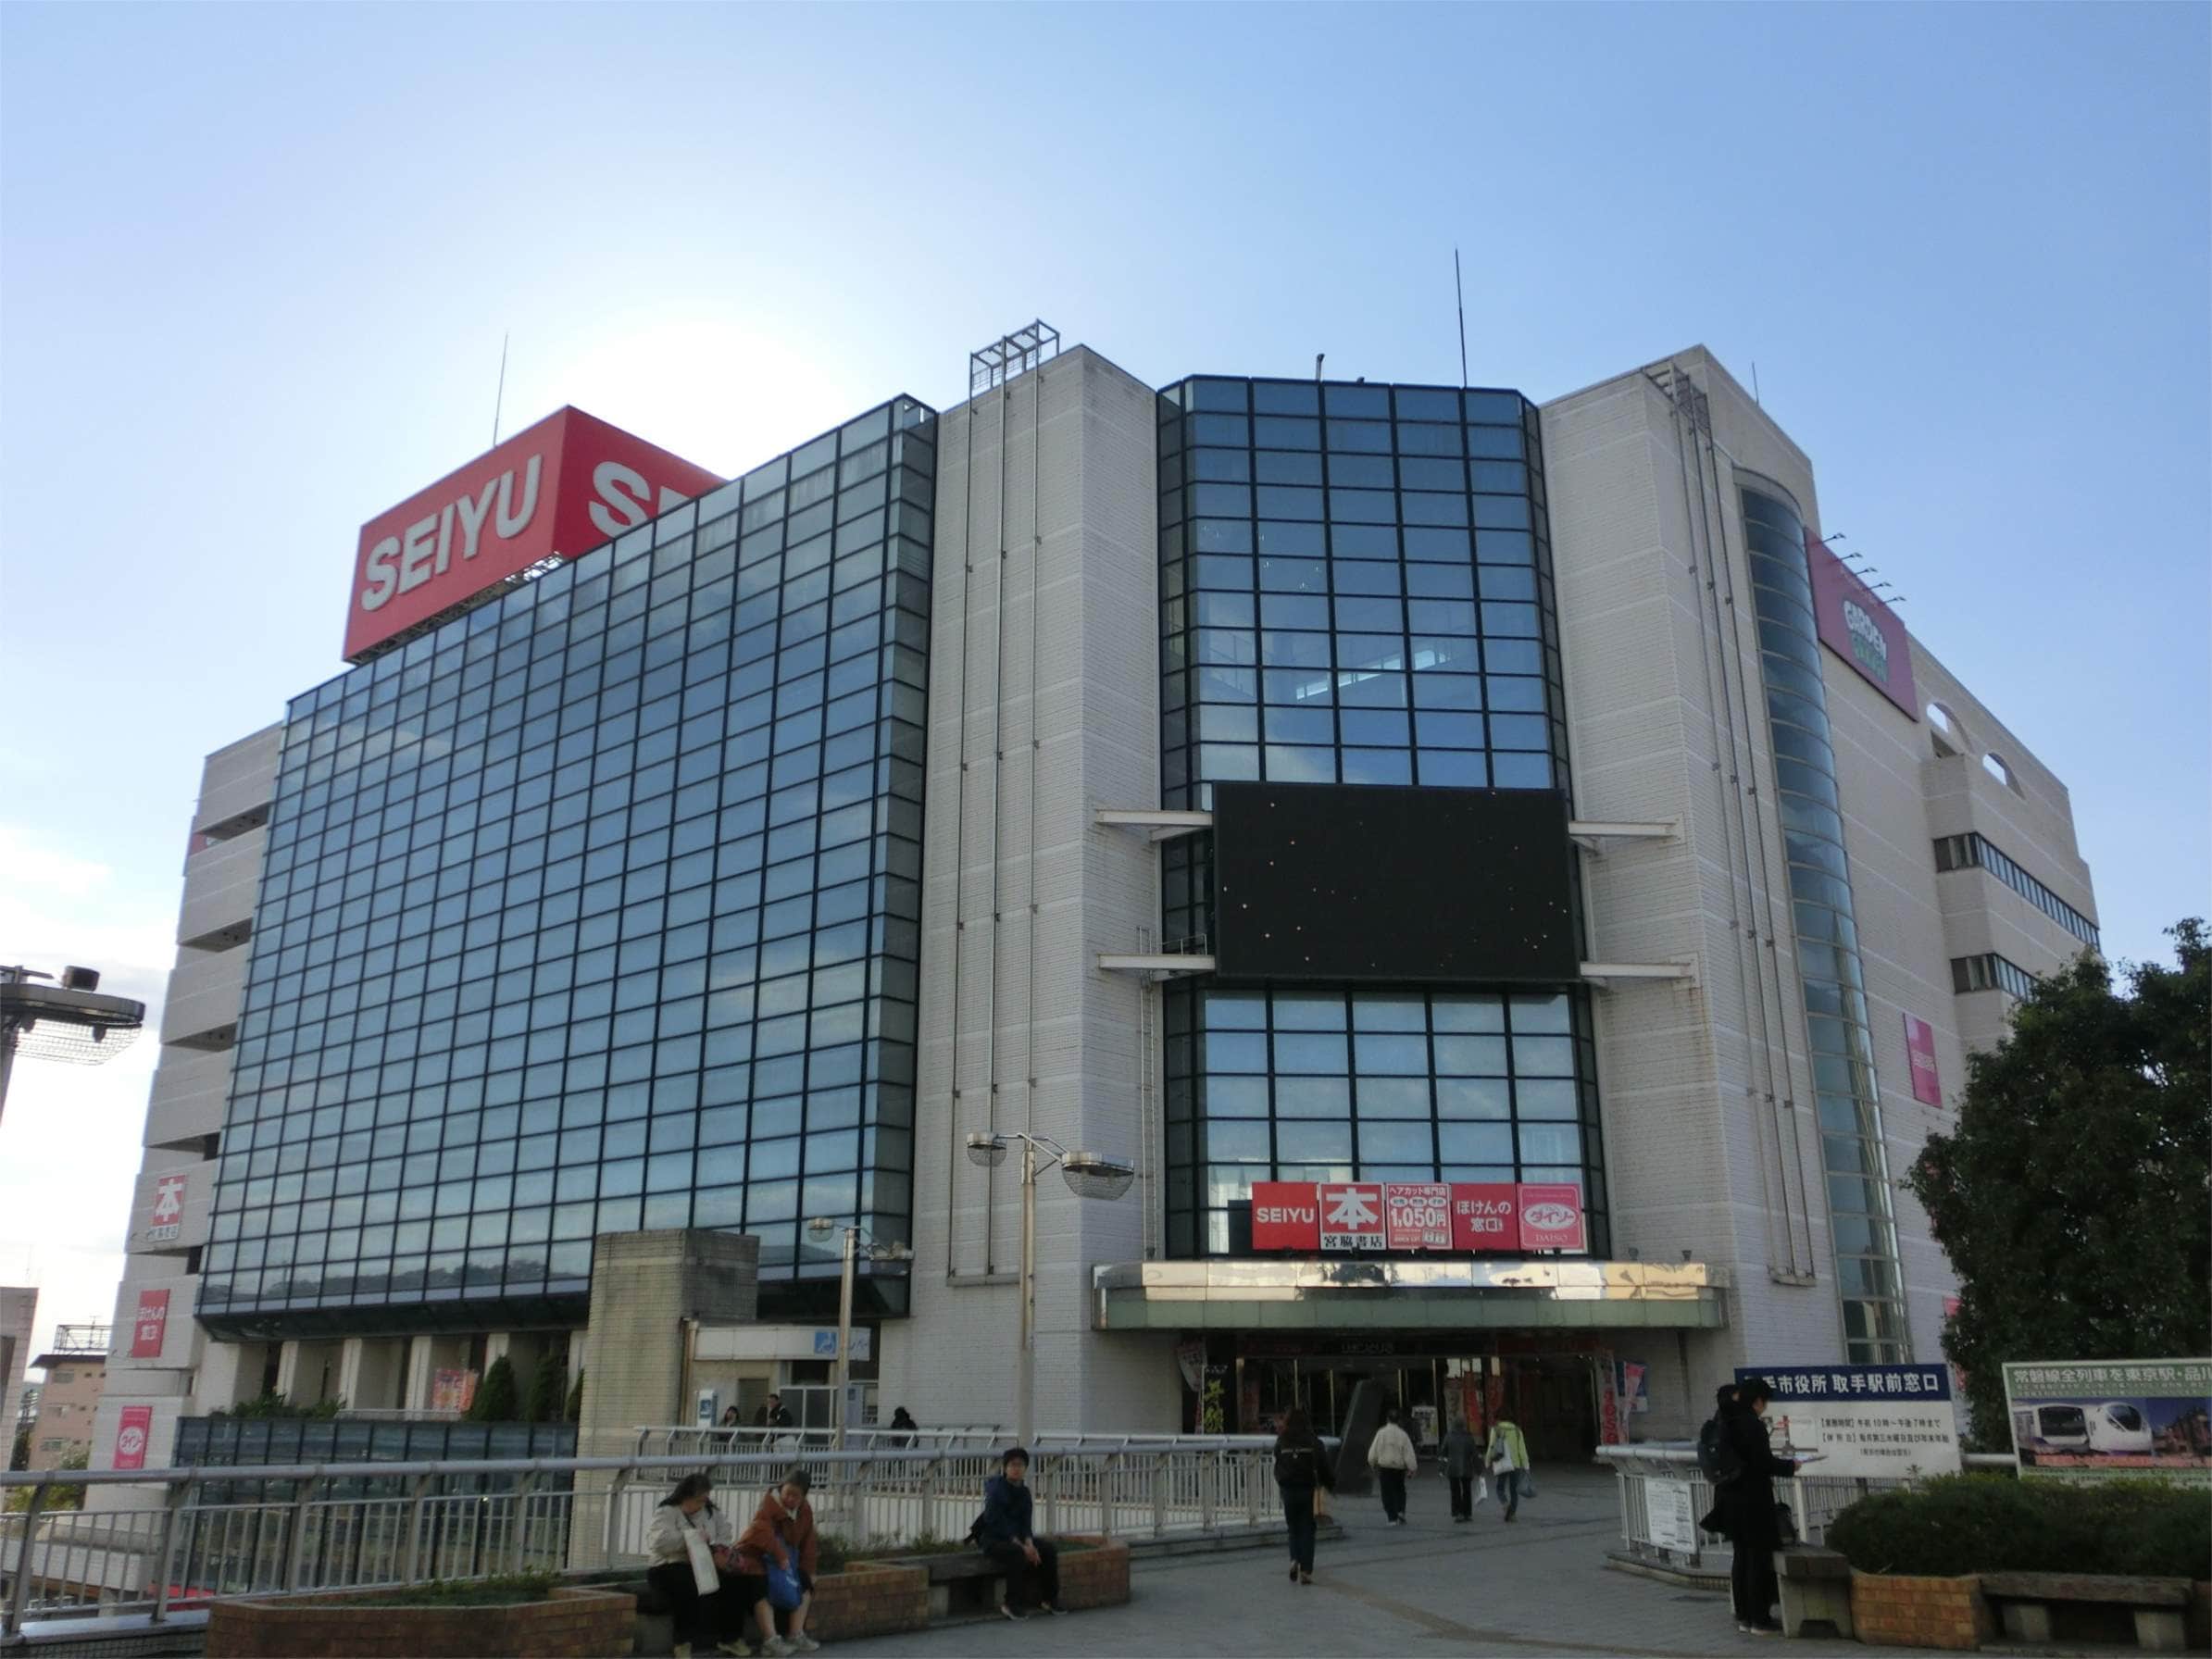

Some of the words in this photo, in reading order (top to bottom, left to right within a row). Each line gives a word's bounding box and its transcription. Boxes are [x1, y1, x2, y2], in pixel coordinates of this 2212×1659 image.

[361, 454, 544, 612] SEIYU
[156, 1178, 182, 1222] 本
[1326, 1187, 1379, 1230] 本
[1456, 1201, 1512, 1216] ほけんの
[1256, 1207, 1315, 1223] SEIYU
[1391, 1207, 1446, 1229] 1,050円
[1470, 1217, 1498, 1232] 窓口
[1530, 1209, 1574, 1224] ダイソー
[1324, 1234, 1383, 1248] 宮脇書店
[1744, 1374, 1828, 1394] 手市役所
[1832, 1372, 1940, 1393] 取手駅前窓口
